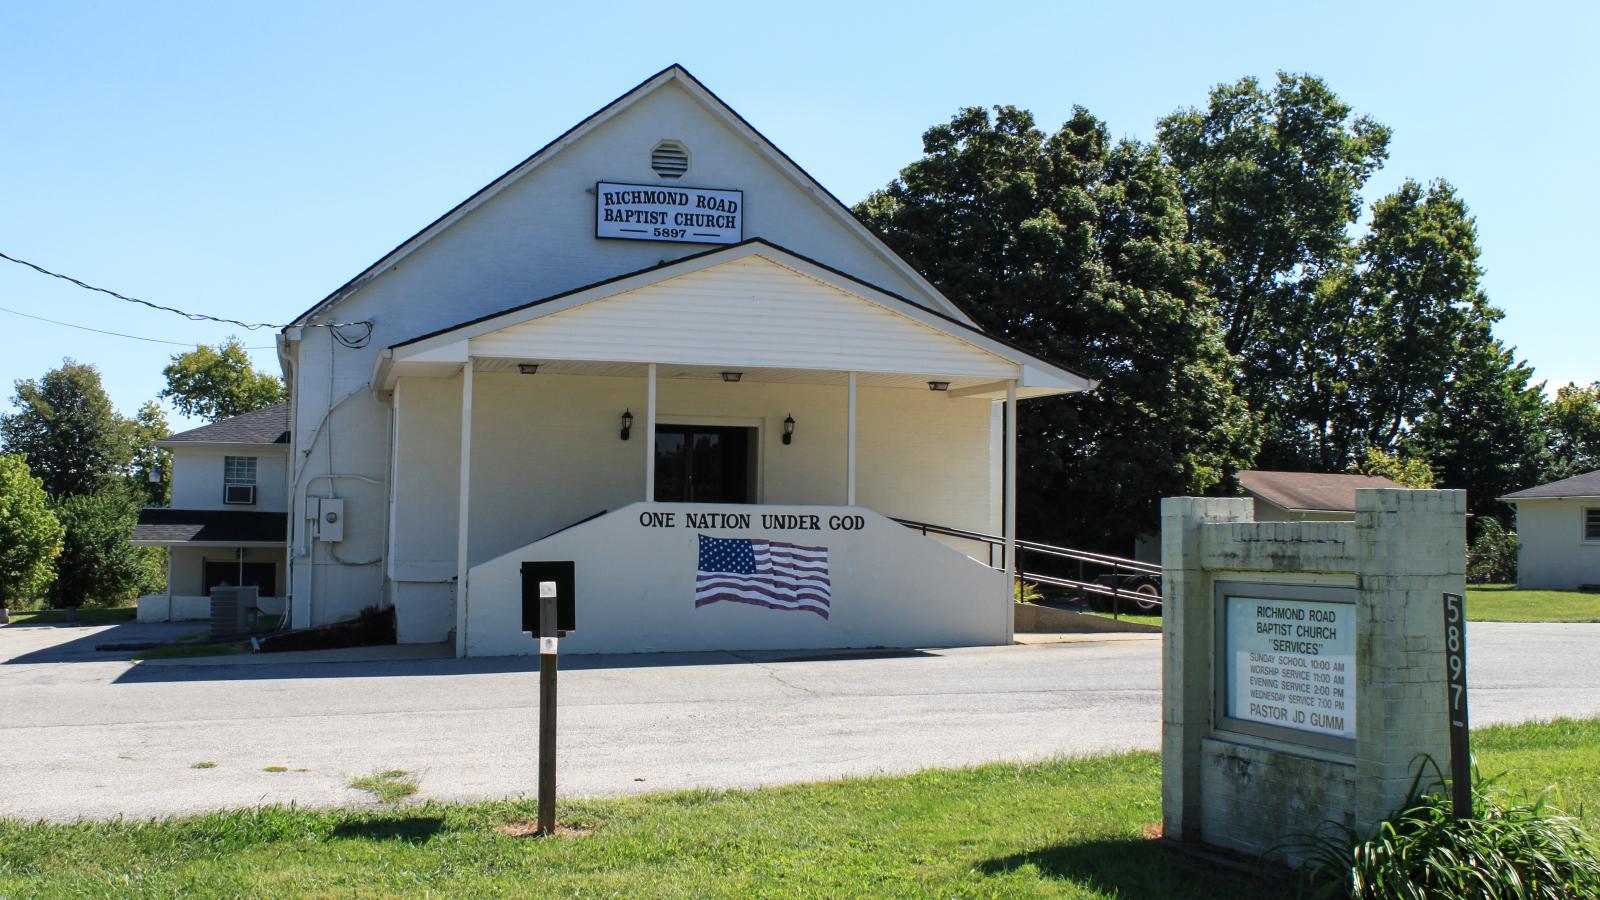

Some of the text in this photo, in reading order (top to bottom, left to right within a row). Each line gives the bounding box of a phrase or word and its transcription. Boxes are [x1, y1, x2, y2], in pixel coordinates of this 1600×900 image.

[604, 191, 737, 214] RICHMOND ROAD
[604, 208, 736, 229] BAPTIST CHURCH
[653, 228, 686, 238] 5897
[639, 511, 865, 531] ONE NATION UNDER GOD
[1256, 606, 1336, 623] RICHMOND ROAD
[1256, 622, 1337, 640] BAPTIST CHURCH
[1269, 639, 1324, 656] "SERVICES"
[1447, 596, 1462, 710] 5897
[1250, 652, 1345, 672] SUNDAY SCHOOL 10:00 AM
[1250, 665, 1345, 685] WORSHIP SERVICE 11:00 AM
[1250, 677, 1344, 698] EVENING SERVICE 2:00 PM
[1250, 690, 1345, 711] WEDNESDAY SERVICE 7:00 PM
[1250, 704, 1344, 731] PASTOR JD GUMM
